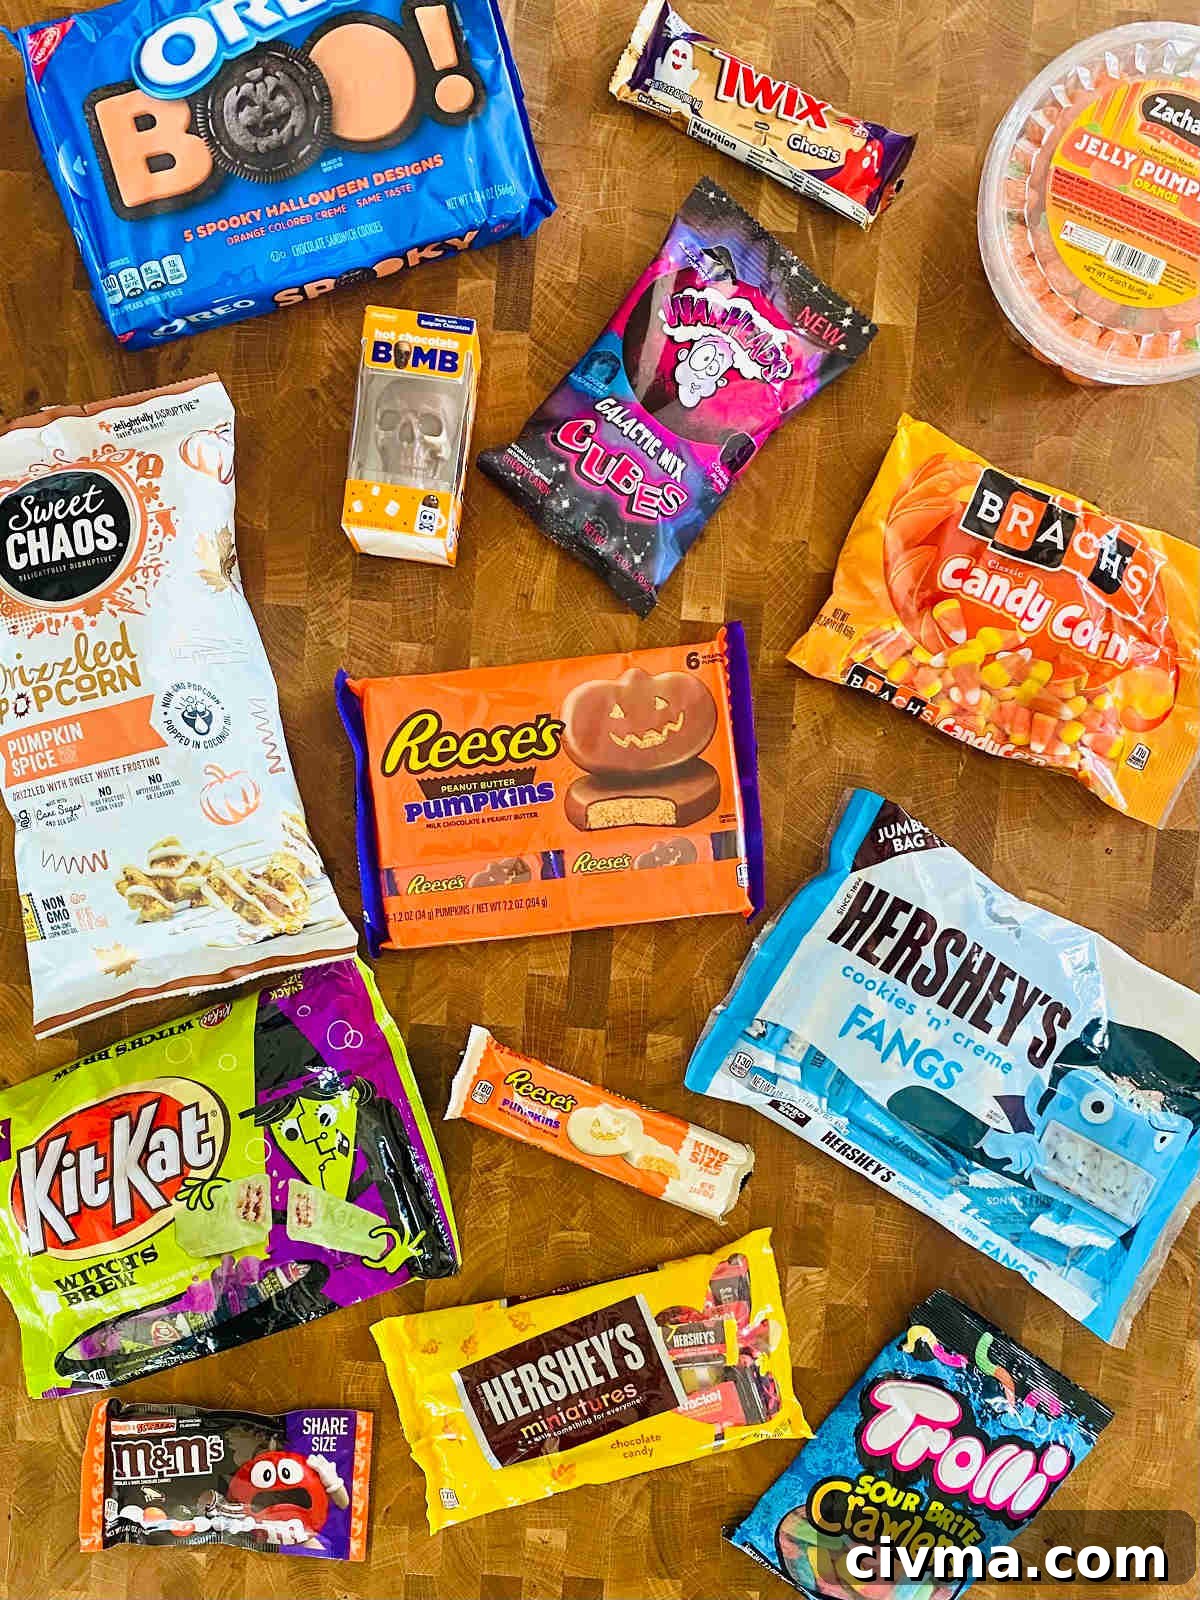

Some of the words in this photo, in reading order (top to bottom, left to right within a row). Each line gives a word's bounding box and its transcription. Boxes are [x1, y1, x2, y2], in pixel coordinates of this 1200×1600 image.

[92, 3, 476, 209] BOO!
[693, 122, 736, 150] Nutrition
[788, 134, 841, 163] Ghosts
[1074, 134, 1137, 170] JELLY
[1139, 160, 1200, 202] PUMP
[184, 230, 194, 242] 5
[196, 209, 262, 239] SPOOKY
[266, 177, 370, 218] HALLOWEEN
[372, 154, 444, 186] DESIGNS
[1134, 178, 1178, 204] ORANGE
[226, 227, 265, 246] ORANGE
[268, 214, 312, 234] COLORED
[315, 205, 347, 222] CREME
[356, 194, 383, 208] SAME
[384, 184, 414, 198] TASTE
[292, 237, 326, 257] CHOCOLATE
[327, 228, 356, 248] SANDWICH
[356, 221, 384, 240] COOKIES
[152, 300, 256, 336] OREO
[796, 306, 847, 346] NEW
[374, 329, 396, 341] hot
[398, 332, 460, 348] chocolate
[372, 340, 459, 373] BOMB
[113, 410, 154, 432] delightfully
[595, 398, 662, 456] GALACTIC
[658, 448, 688, 482] MIX
[557, 419, 688, 519] CUBES
[8, 484, 104, 531] Sweet
[976, 489, 1150, 597] BRACH'S
[18, 564, 66, 582] DELIGHTFULLY
[987, 558, 1025, 578] Classic
[941, 557, 1052, 632] Candy
[1051, 605, 1131, 662] Corn
[686, 652, 700, 670] 6
[8, 722, 84, 760] PUMPKIN
[164, 719, 190, 746] POPPED
[192, 740, 201, 750] IN
[203, 726, 230, 750] COCONUT
[383, 711, 564, 774] Reese's
[12, 750, 58, 778] SPICE
[12, 784, 46, 801] DRIZZLED
[46, 778, 68, 792] WITH
[69, 772, 94, 787] SWEET
[96, 766, 121, 780] WHITE
[123, 756, 160, 774] FROSTING
[98, 786, 112, 798] NO
[148, 773, 162, 784] NO
[441, 782, 478, 792] PEANUT
[480, 778, 516, 790] BUTTER
[36, 808, 56, 821] Cane
[58, 804, 83, 818] Sugar
[426, 821, 442, 830] MILK
[443, 818, 480, 828] CHOCOLATE
[487, 814, 512, 824] PEANUT
[514, 812, 538, 820] BUTTER
[892, 834, 925, 852] BAG
[572, 852, 632, 873] Reese's
[408, 874, 465, 895] Reese's
[42, 895, 66, 911] NON
[46, 908, 70, 924] GMO
[404, 910, 414, 922] OZ
[435, 904, 470, 918] PUMPKINS
[476, 902, 488, 914] NET
[490, 900, 500, 912] WT
[504, 900, 514, 911] 7.2
[514, 898, 524, 909] OZ
[837, 894, 852, 914] SINCE
[826, 880, 1072, 1070] HERSHEY'S
[842, 964, 916, 1016] cookies
[952, 1032, 1013, 1074] creme
[116, 1021, 194, 1057] WITCH'S
[838, 1003, 964, 1090] FANGS
[737, 1054, 752, 1070] 130
[477, 1082, 492, 1096] 180
[505, 1070, 577, 1112] Reese's
[752, 1074, 762, 1089] NET
[690, 1152, 722, 1168] SIZE
[694, 1141, 728, 1162] KING
[820, 1131, 896, 1182] HERSHEY'S
[54, 1245, 158, 1292] WITCH'S
[62, 1272, 136, 1307] BREW
[674, 1332, 716, 1348] HERSHEY'S
[90, 1370, 106, 1380] 140
[480, 1323, 645, 1424] HERSHEY'S
[521, 1384, 638, 1439] miniatures
[554, 1418, 592, 1437] something
[594, 1412, 605, 1421] for
[302, 1417, 348, 1436] SHARE
[312, 1437, 336, 1452] SIZE
[610, 1434, 662, 1449] chocolate
[624, 1446, 654, 1459] candy
[864, 1381, 1072, 1516] Trolli
[856, 1475, 920, 1513] SOUR
